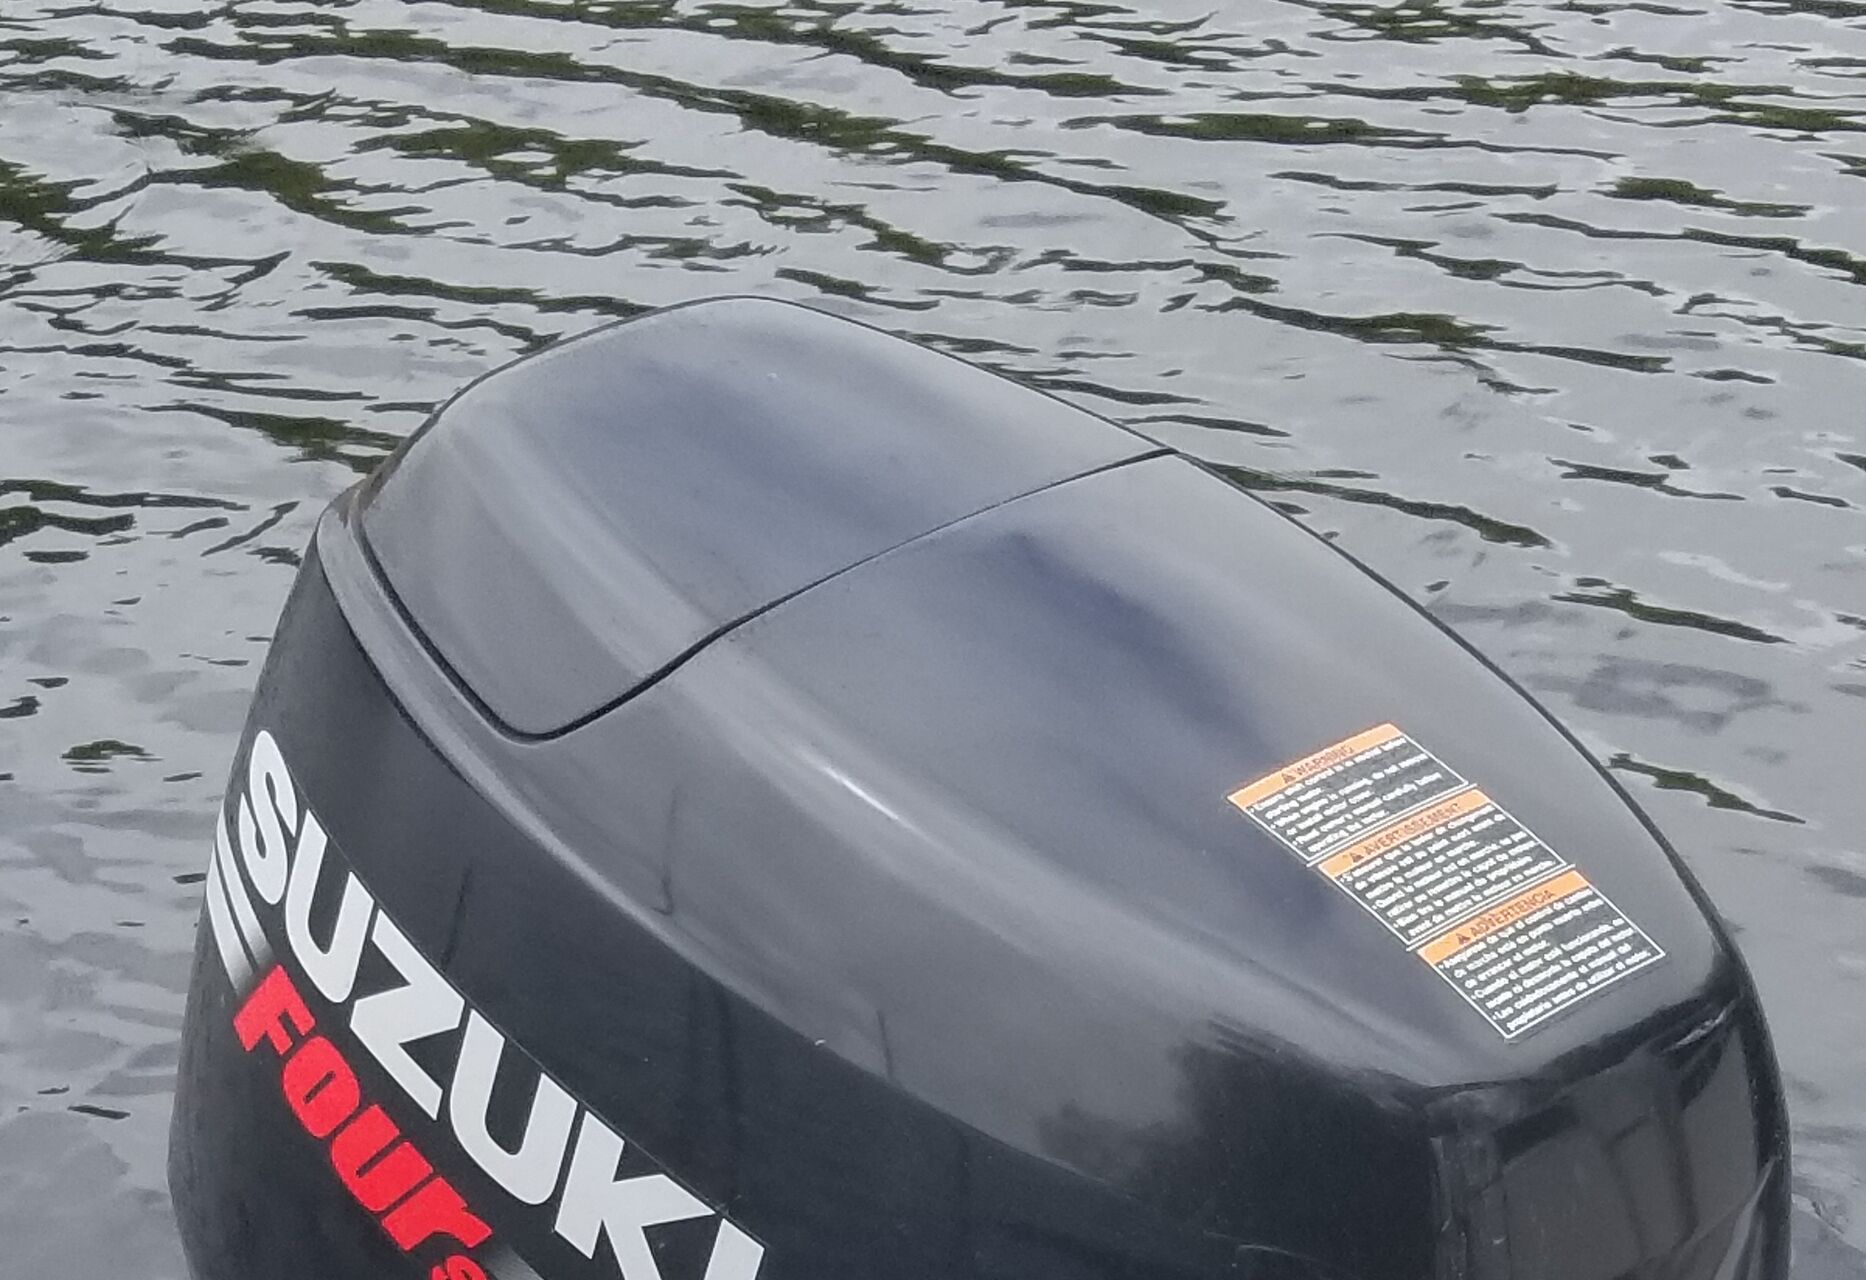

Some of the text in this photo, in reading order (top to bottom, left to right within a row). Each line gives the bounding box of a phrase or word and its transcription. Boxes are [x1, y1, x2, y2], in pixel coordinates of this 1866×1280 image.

[1293, 746, 1353, 777] WARNING
[1364, 803, 1458, 855] AVERTISSEMENT
[1471, 890, 1554, 937] ADVERTENCIA
[233, 963, 493, 1251] Four
